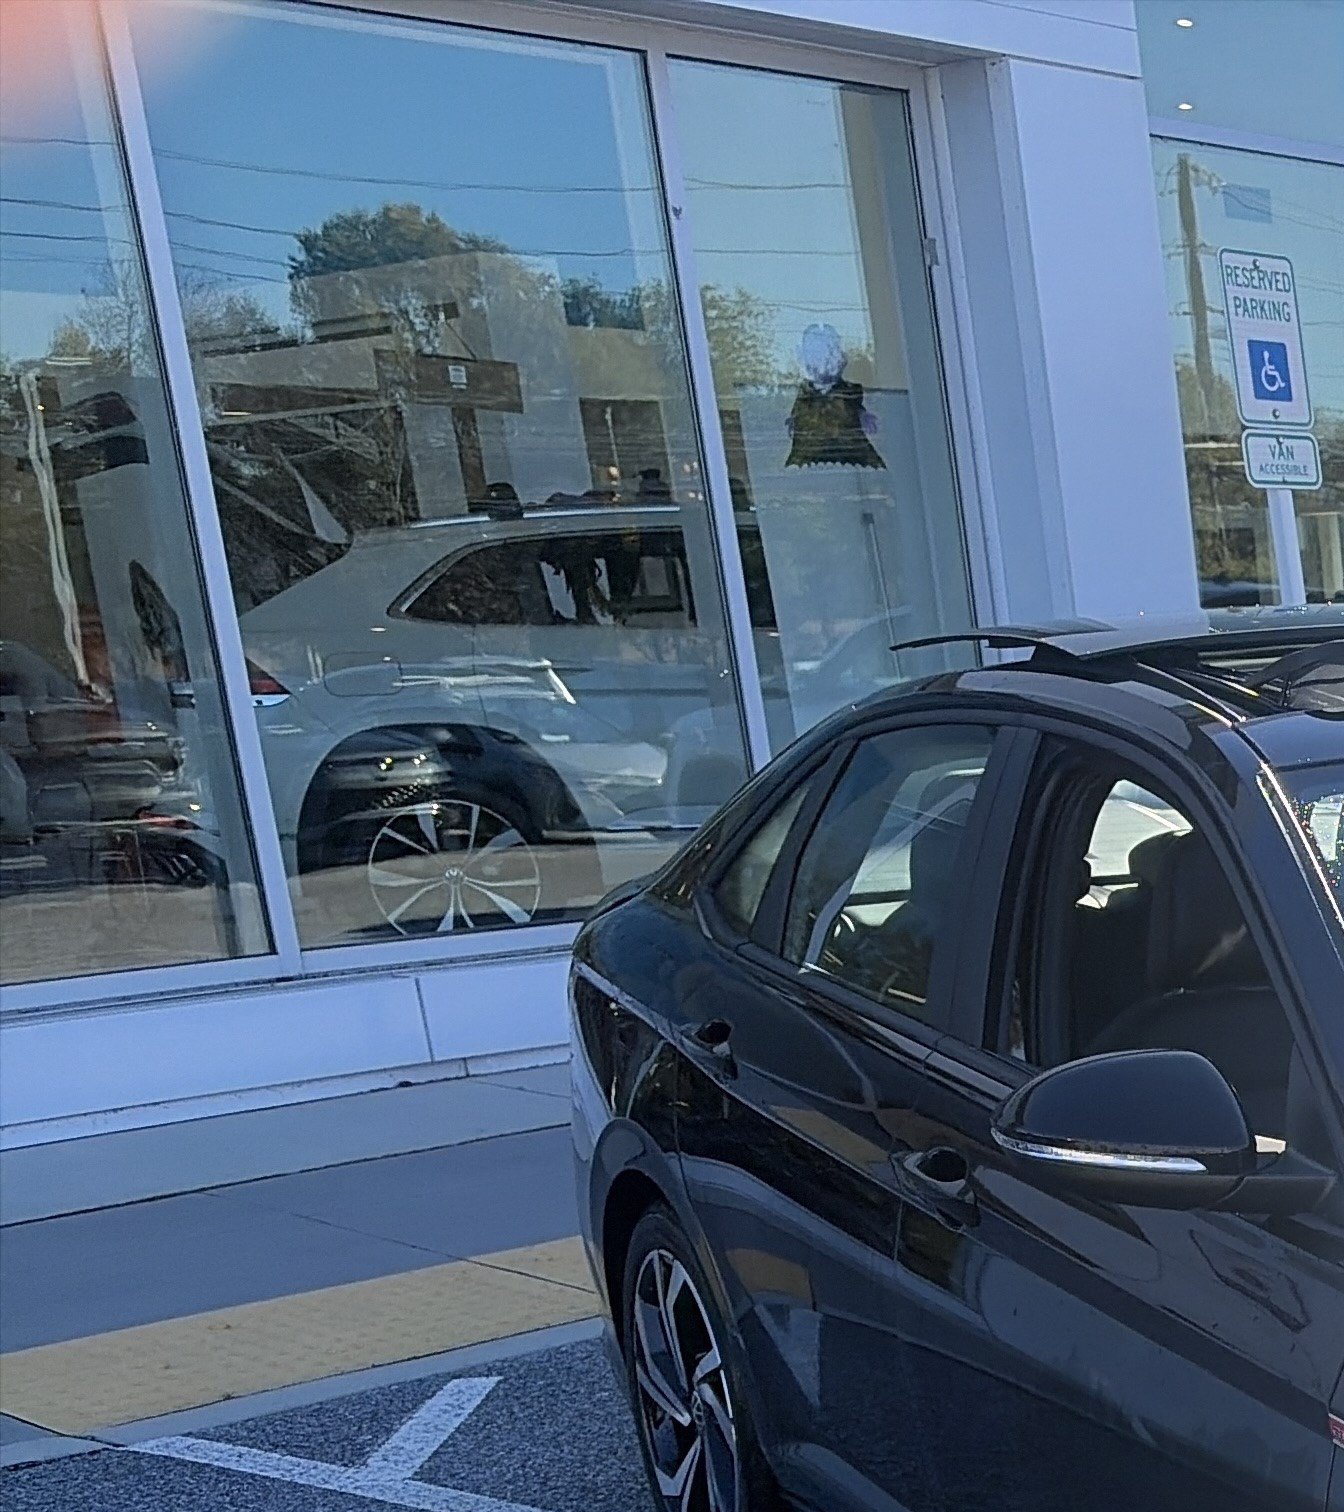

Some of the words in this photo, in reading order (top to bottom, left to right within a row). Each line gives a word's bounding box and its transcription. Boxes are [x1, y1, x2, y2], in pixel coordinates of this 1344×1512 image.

[1225, 264, 1291, 293] RESERVED
[1232, 295, 1291, 323] PARKING
[1269, 443, 1294, 460] VAN
[1259, 463, 1309, 476] ACCESSIBLE
